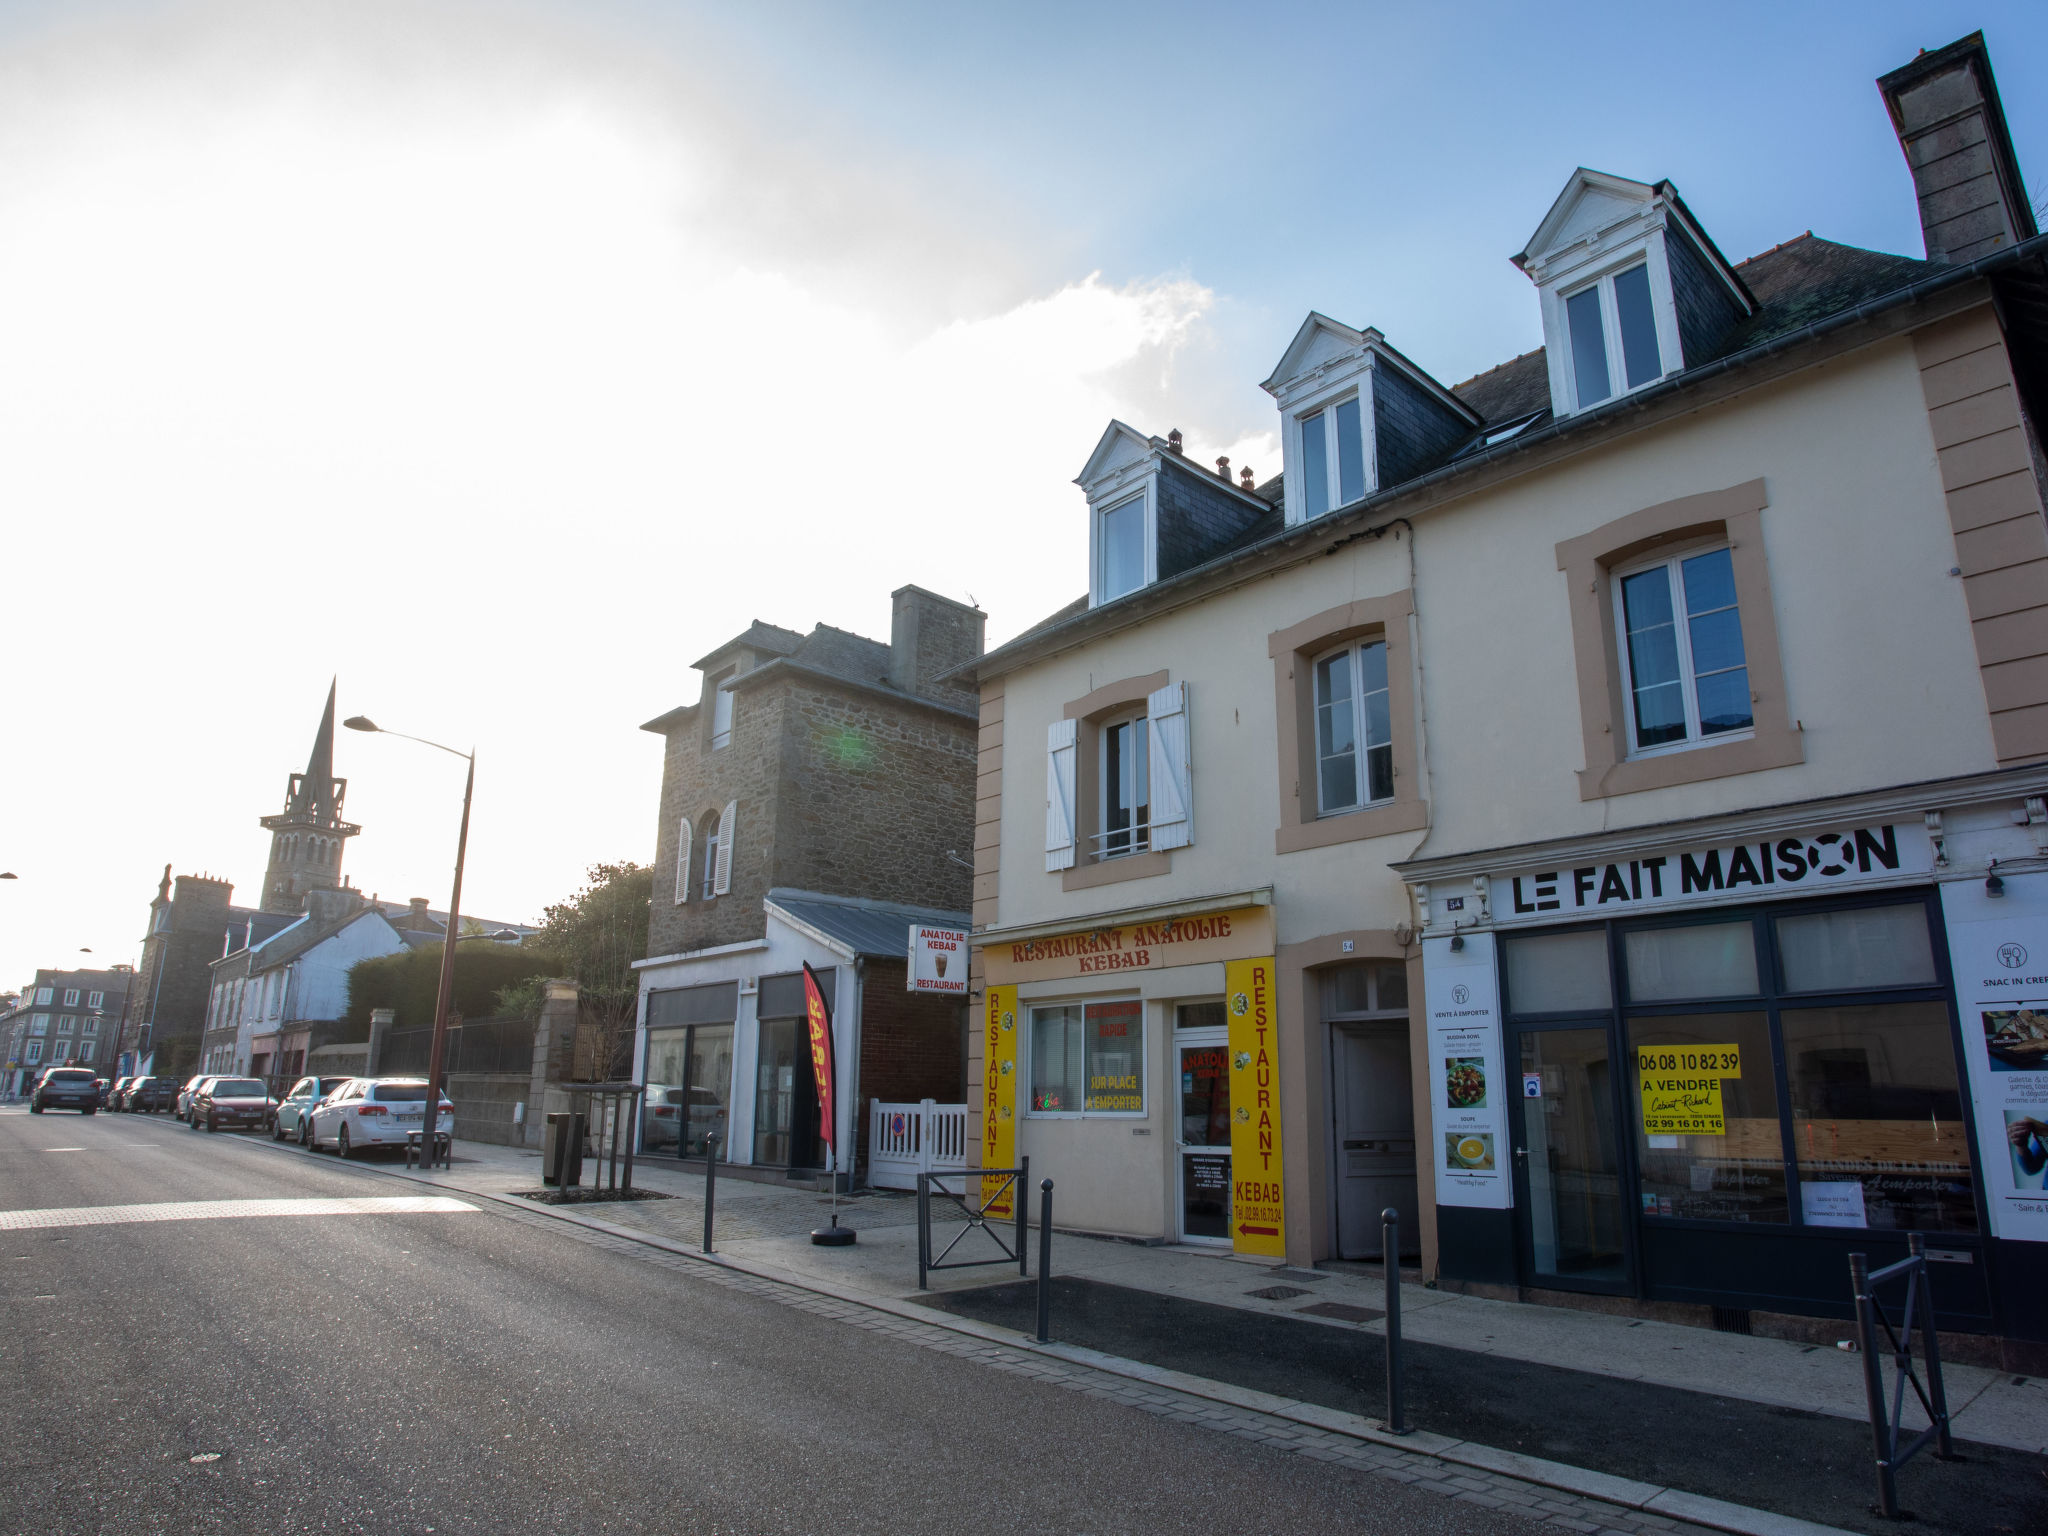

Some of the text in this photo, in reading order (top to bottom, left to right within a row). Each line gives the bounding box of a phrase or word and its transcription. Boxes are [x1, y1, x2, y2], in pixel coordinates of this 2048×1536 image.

[1512, 825, 1900, 914] LE FAIT MAISON
[920, 929, 965, 942] ANATOLIE
[1012, 916, 1232, 963] RESTAURANT ANATOLIE
[927, 940, 957, 951] KEBAB
[1079, 950, 1150, 973] KEBAB
[917, 979, 965, 991] RESTAURANT
[1983, 979, 2010, 987] SNAC
[2012, 977, 2023, 985] IN
[1459, 1009, 1489, 1017] EMPORTER
[1183, 1052, 1229, 1073] ANATOLI
[1253, 967, 1273, 1171] RESTAURANT
[1640, 1053, 1738, 1070] 06 08 10 82 39
[987, 994, 1000, 1158] RESTAURANT
[1091, 1075, 1137, 1089] SUR PLACE
[1657, 1079, 1719, 1091] VENDRE
[1095, 1095, 1142, 1109] EMPORTER
[1652, 1091, 1712, 1113] Cabinet Richard
[1646, 1120, 1722, 1128] 02 99 16 01 16
[1236, 1181, 1280, 1203] KEBAB
